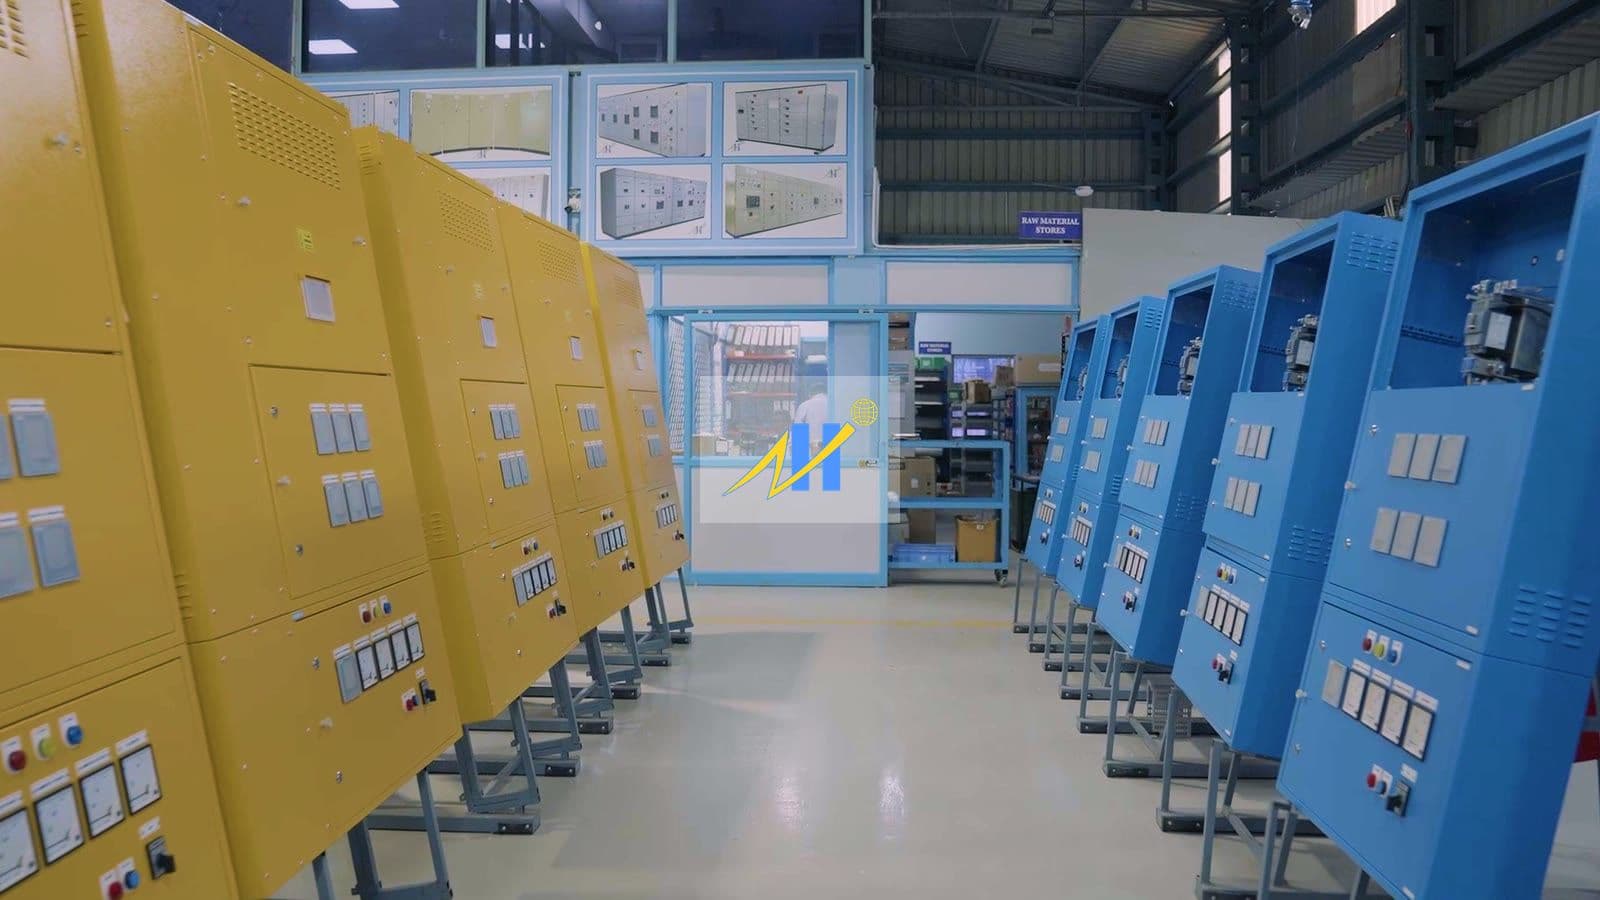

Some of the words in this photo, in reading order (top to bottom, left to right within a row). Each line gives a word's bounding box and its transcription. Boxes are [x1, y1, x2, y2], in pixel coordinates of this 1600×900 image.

[1022, 216, 1039, 224] RAW
[1040, 217, 1080, 225] MATERIAL
[1035, 226, 1066, 234] STORES
